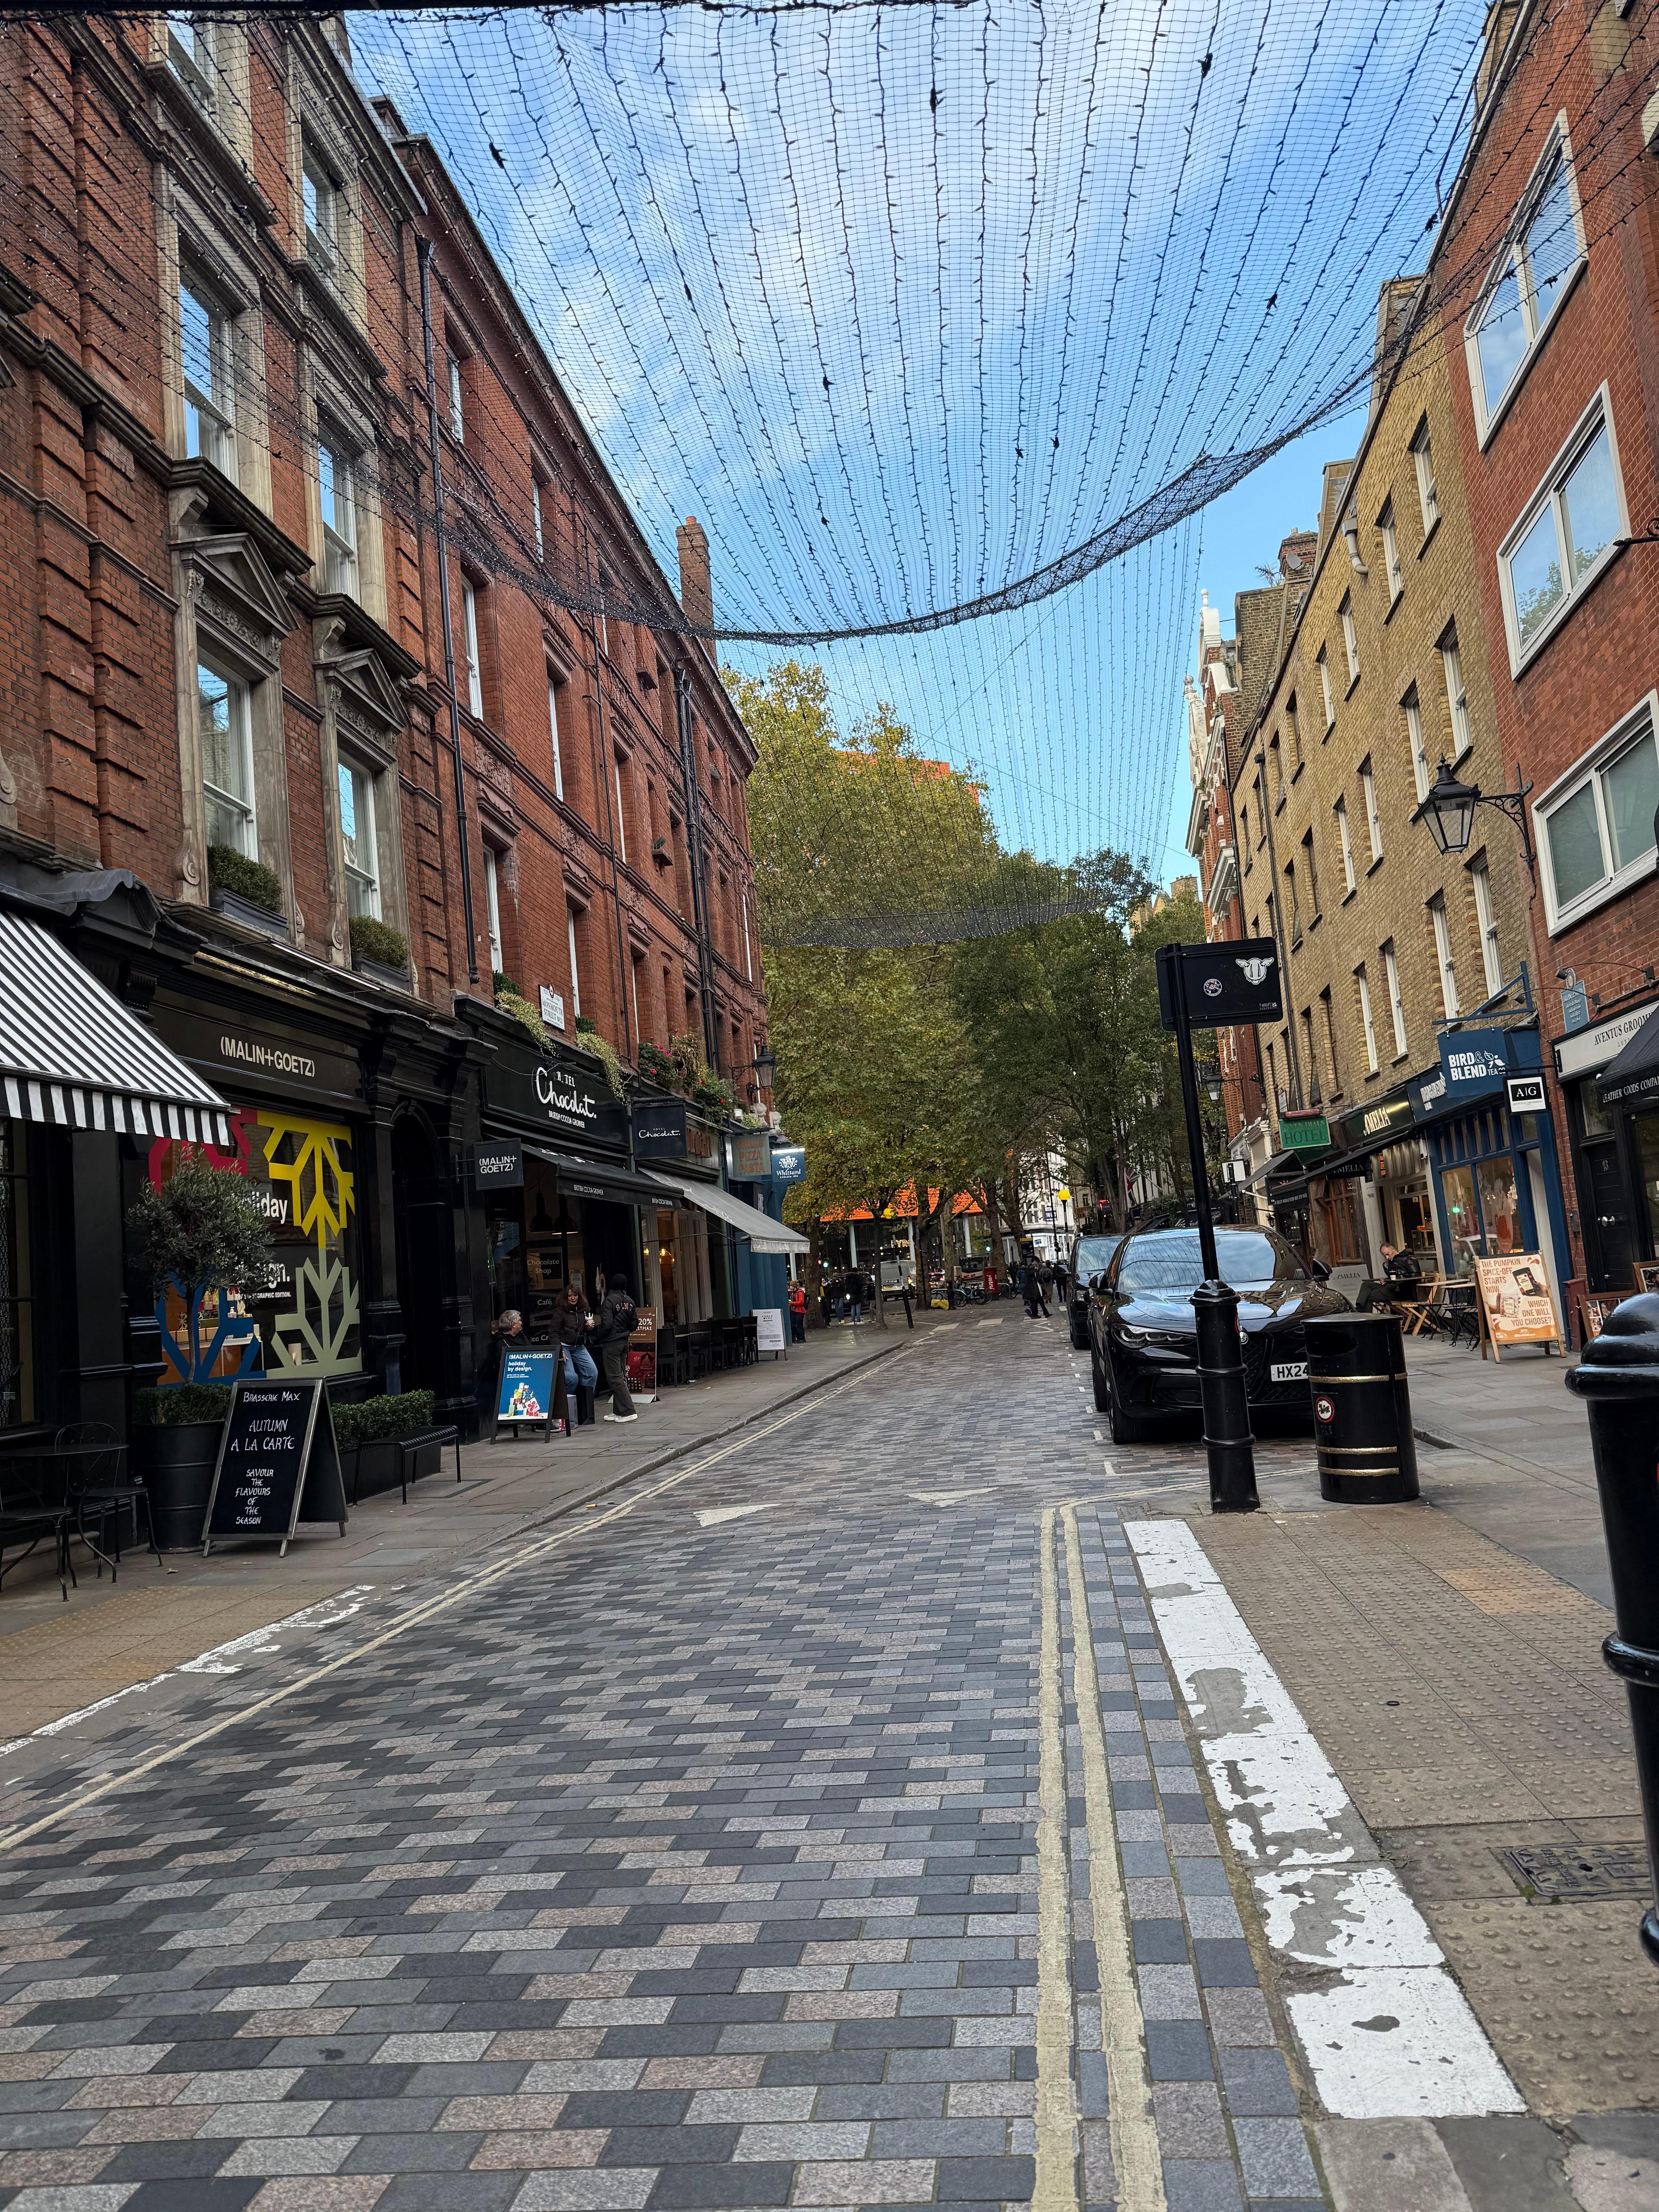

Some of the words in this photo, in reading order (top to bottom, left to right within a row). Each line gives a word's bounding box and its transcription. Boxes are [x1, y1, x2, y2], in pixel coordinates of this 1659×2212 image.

[1595, 1025, 1622, 1045] AVENTUS
[221, 1037, 315, 1077] (MALIN+GOETZ)
[1448, 1053, 1475, 1067] BIRD
[1475, 1051, 1484, 1063] &
[1451, 1065, 1486, 1080] BLEND
[1602, 1089, 1623, 1103] LEATHER
[1284, 1128, 1326, 1144] HOTEL
[739, 1150, 763, 1161] PIZZA
[479, 1156, 517, 1166] (MALIN+
[480, 1163, 513, 1174] GOETZ)
[739, 1162, 764, 1173] PASTA
[1494, 1258, 1521, 1266] PUMPKIN
[1483, 1267, 1512, 1276] SPICE-OFF
[1484, 1276, 1507, 1285] STARTS
[1528, 1300, 1548, 1308] WHICH
[1525, 1317, 1552, 1326] CHOOSE?
[282, 1391, 301, 1401] MAX
[249, 1419, 288, 1432] AUTUMN
[231, 1439, 239, 1451] A
[245, 1438, 258, 1451] LA
[263, 1436, 295, 1450] CARTE
[251, 1478, 263, 1486] THE
[235, 1487, 271, 1497] FLAVOURS
[247, 1497, 259, 1505] OF
[245, 1506, 259, 1515] THE
[235, 1516, 261, 1525] SEASON
